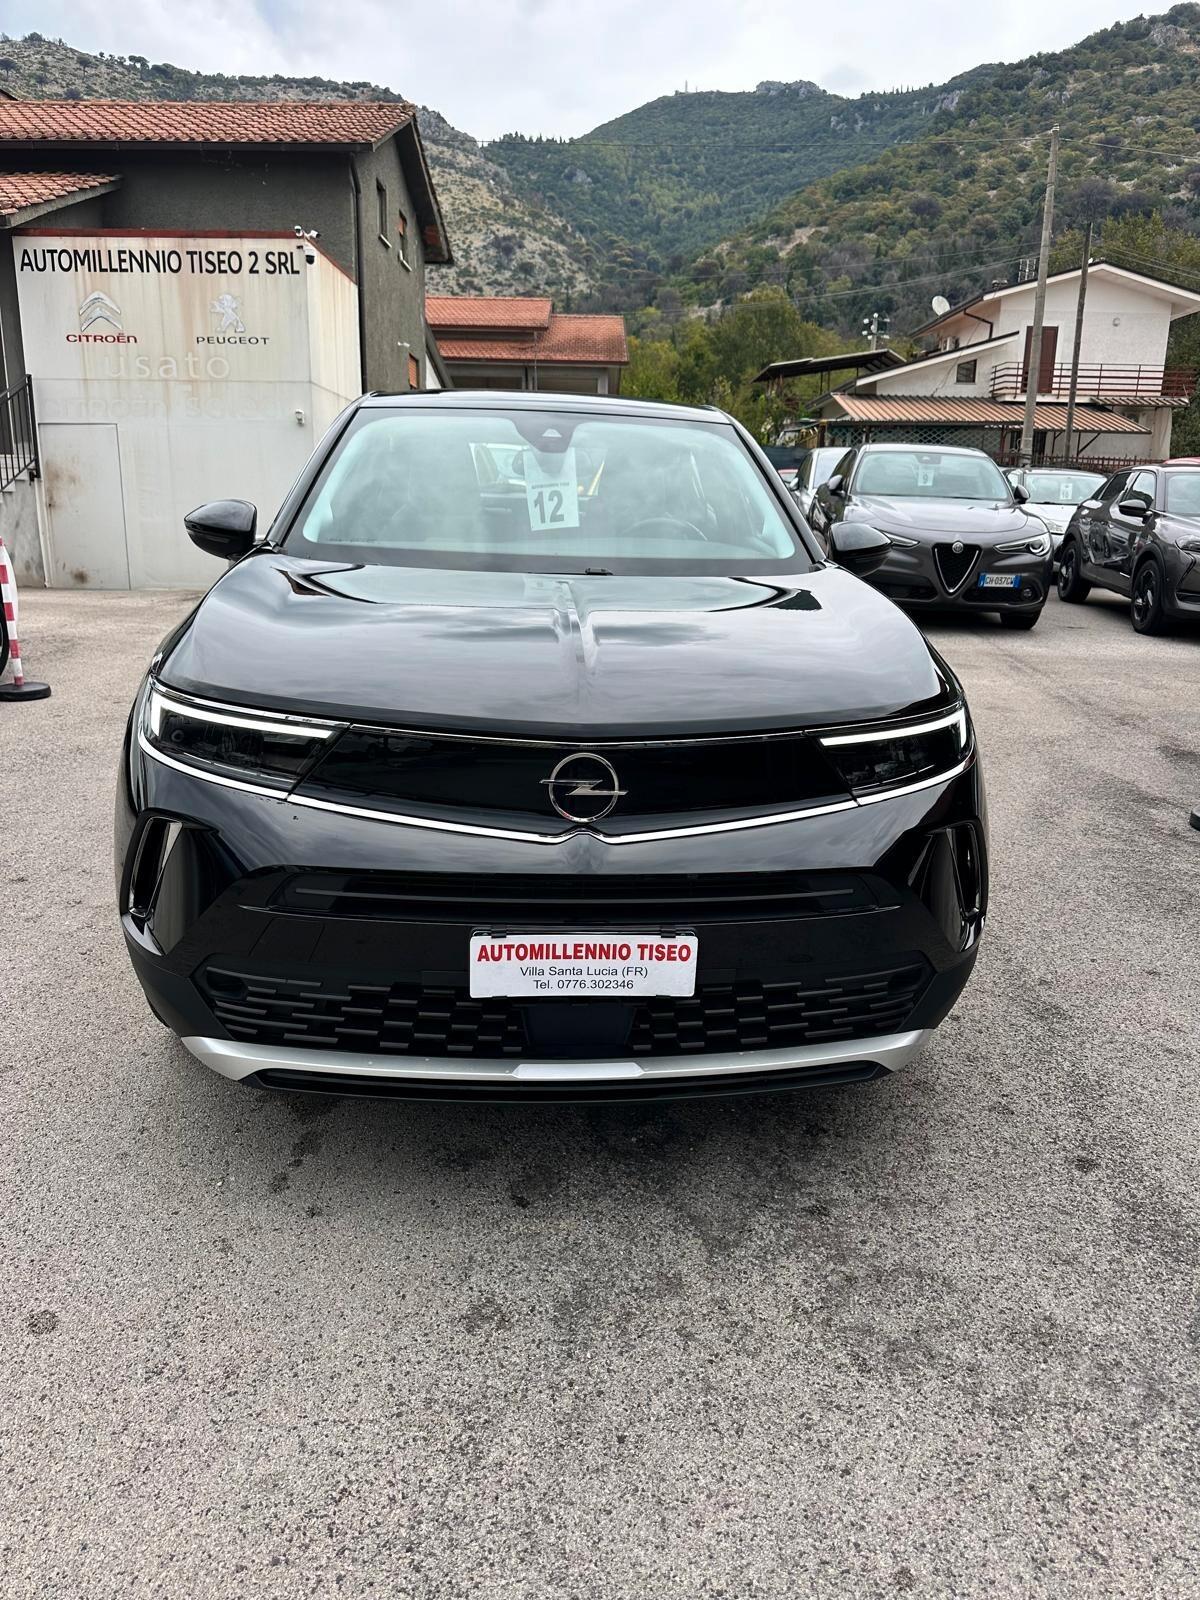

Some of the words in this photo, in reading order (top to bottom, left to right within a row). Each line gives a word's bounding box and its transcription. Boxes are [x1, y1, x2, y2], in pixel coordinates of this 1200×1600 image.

[20, 248, 182, 274] AUTOMILLENNIO
[186, 250, 243, 275] TISEO
[248, 251, 260, 274] 2
[265, 251, 300, 275] SRL
[196, 336, 270, 345] PEUGEOT
[105, 351, 230, 379] usato
[533, 489, 565, 524] 12
[477, 943, 632, 962] AUTOMILLENNIO
[637, 943, 692, 962] TISEO
[520, 966, 545, 977] Villa
[548, 966, 583, 977] Santa
[587, 967, 618, 977] Lucia
[622, 966, 648, 978] (FR)
[533, 979, 553, 989] Tel.
[557, 979, 634, 989] 0776.302346
